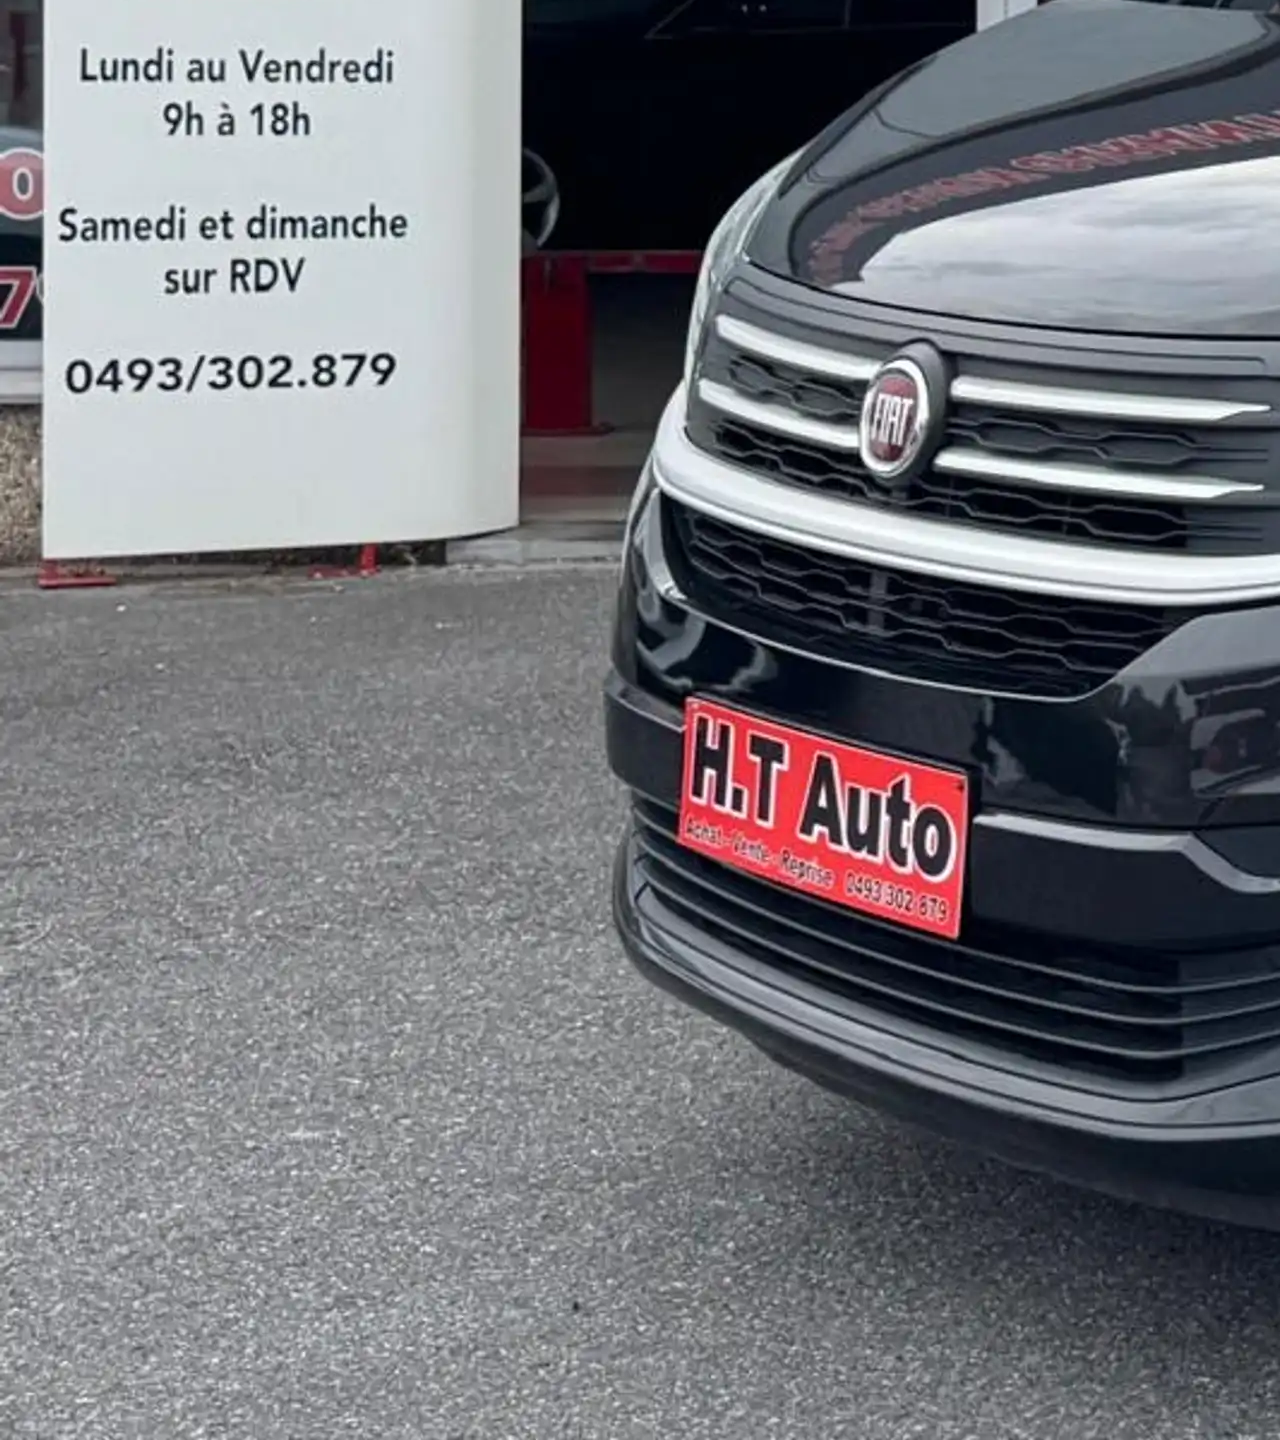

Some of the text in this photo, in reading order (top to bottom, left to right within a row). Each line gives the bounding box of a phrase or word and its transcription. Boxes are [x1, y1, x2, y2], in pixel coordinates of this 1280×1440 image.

[80, 46, 394, 84] Lundi au Vendredi
[163, 100, 311, 136] 9h à 18h
[58, 203, 408, 242] Samedi et dimanche
[164, 257, 306, 294] sur RDV
[65, 353, 397, 394] 0493/302.879
[691, 713, 957, 883] H.T Auto
